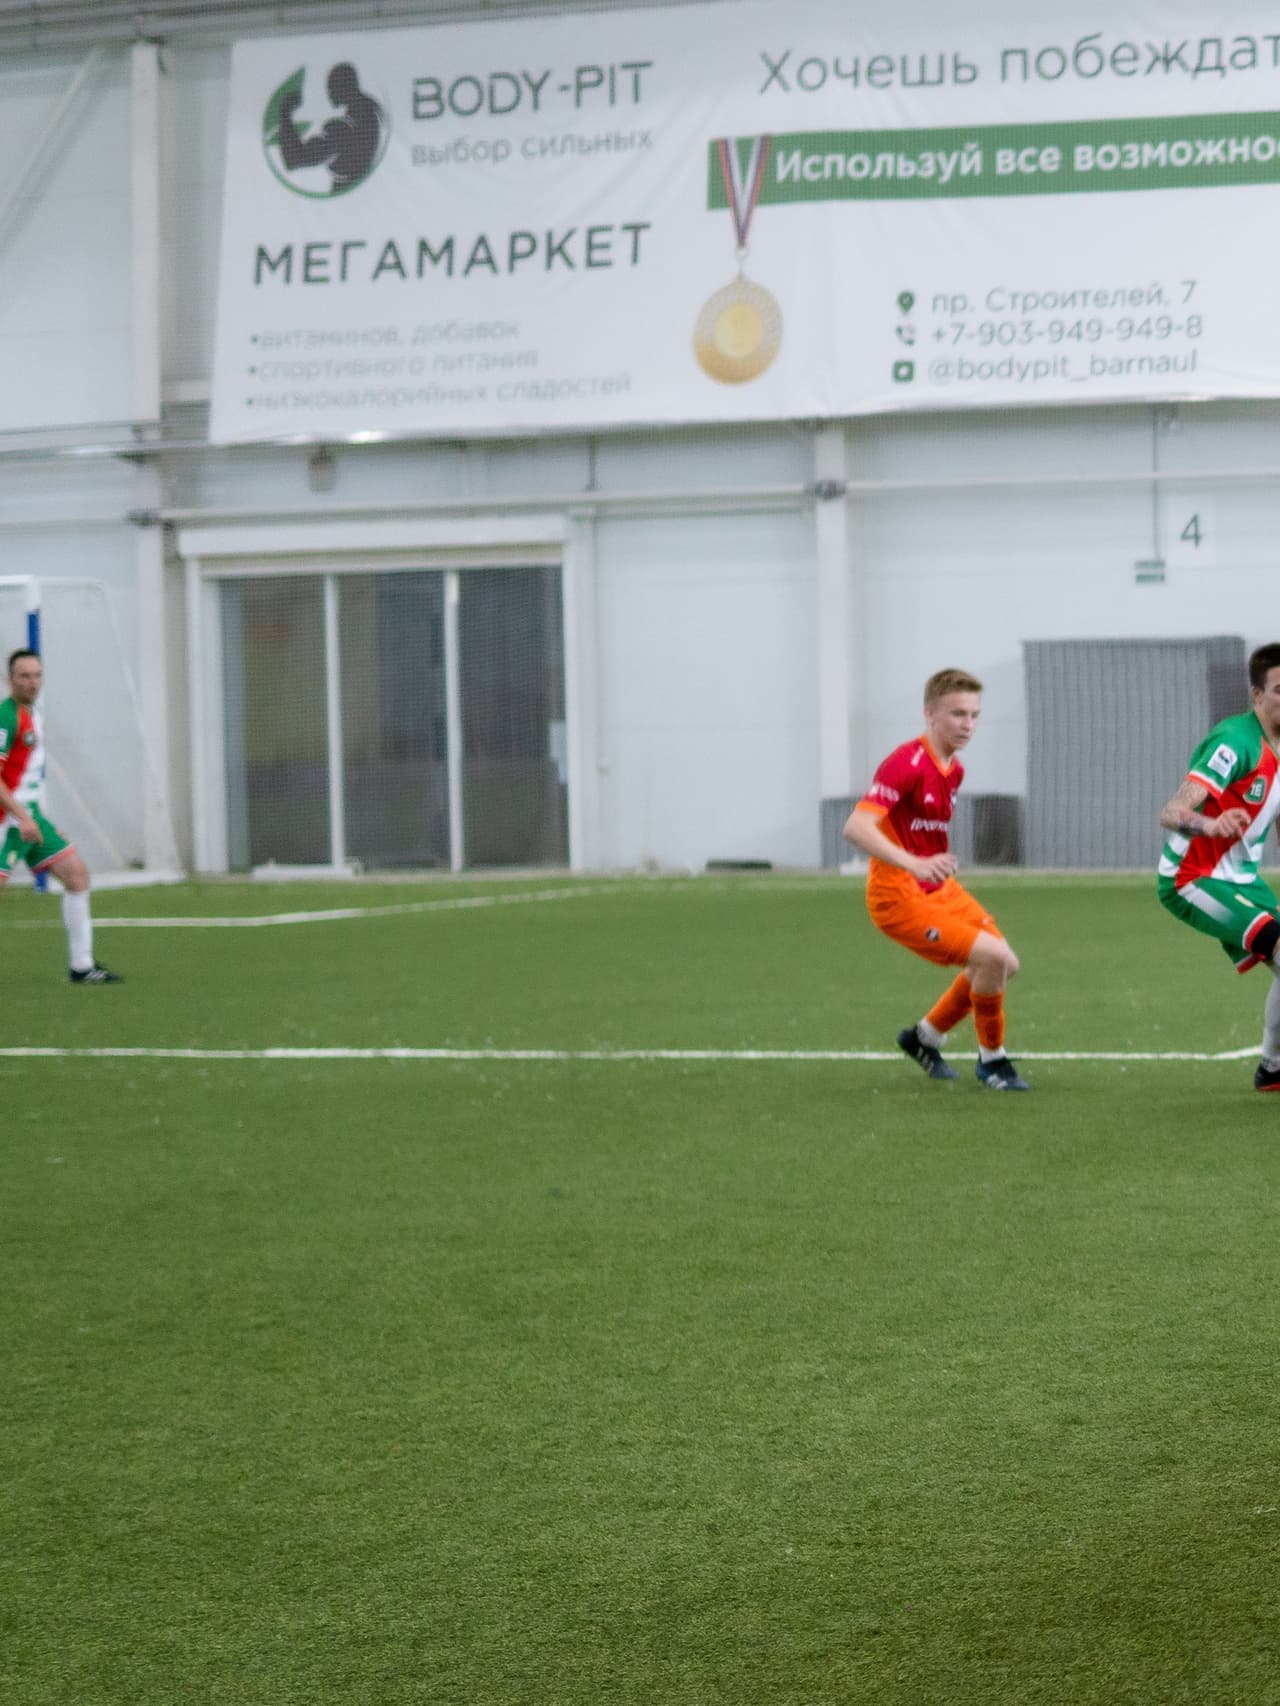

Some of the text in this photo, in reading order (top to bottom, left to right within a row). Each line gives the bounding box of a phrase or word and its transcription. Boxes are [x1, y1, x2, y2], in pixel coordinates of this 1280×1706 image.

[412, 60, 654, 121] BODY-PIT
[757, 48, 978, 95] Хочешь
[411, 129, 654, 167] выбор сильных
[774, 141, 984, 184] Используй
[996, 145, 1061, 175] все
[253, 221, 653, 287] МЕГАМАРКЕТ
[932, 292, 975, 317] пр.
[1180, 279, 1199, 306] 7
[931, 313, 1204, 347] +7-903-949-949-8
[928, 348, 1199, 386] @bodypit_barnaul
[1180, 512, 1204, 550] 4
